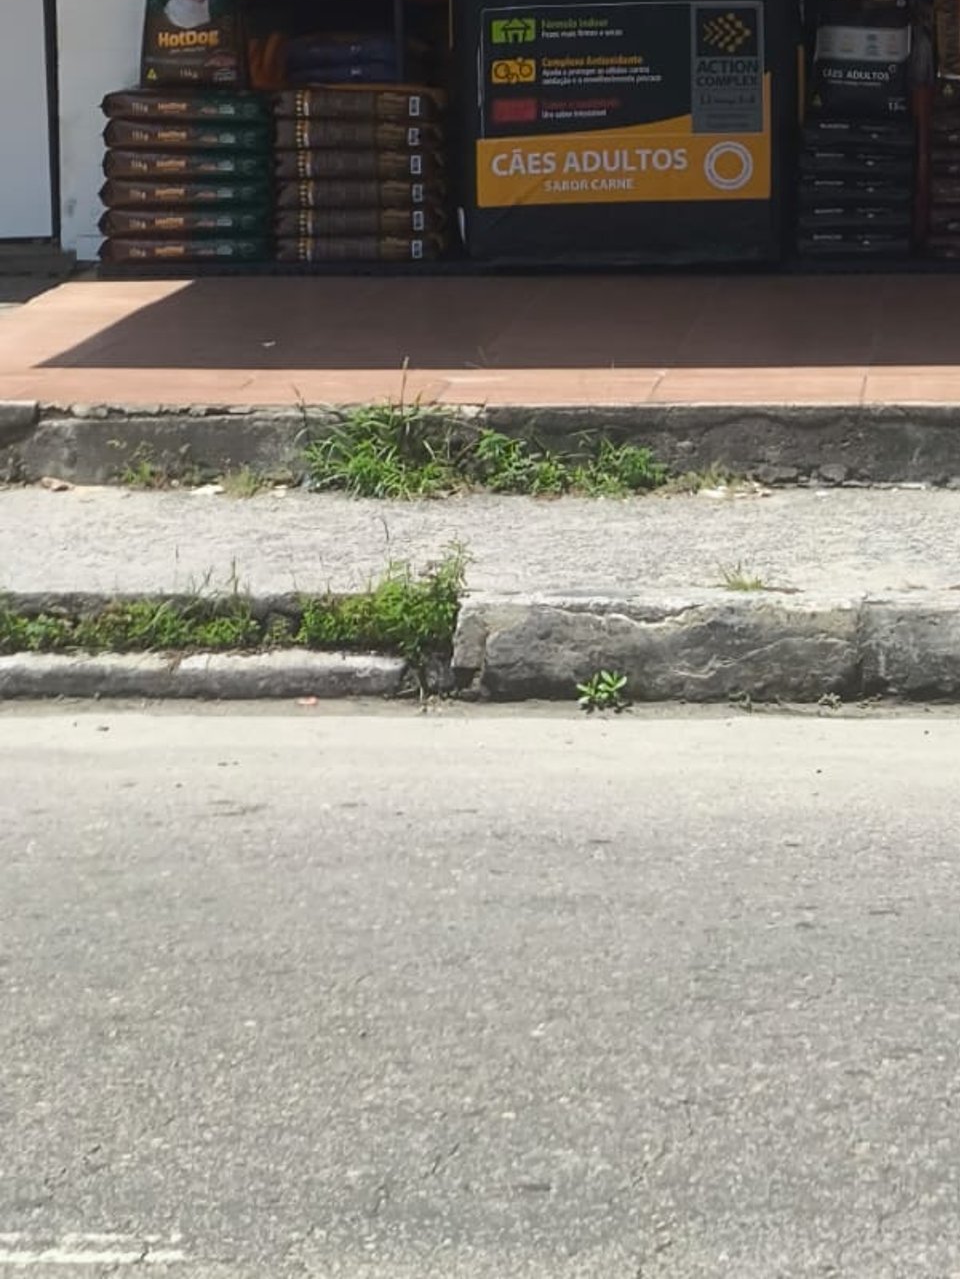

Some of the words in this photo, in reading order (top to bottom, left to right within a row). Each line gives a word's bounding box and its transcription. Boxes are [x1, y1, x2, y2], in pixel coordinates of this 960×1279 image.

[158, 30, 219, 47] HotDog
[694, 57, 760, 76] ACTION
[694, 74, 759, 88] COMPLEX
[847, 69, 890, 81] ADULTOS
[490, 148, 556, 176] CÃES
[562, 147, 689, 174] ADULTOS
[543, 178, 588, 192] SABOR
[589, 177, 636, 191] CARNE
